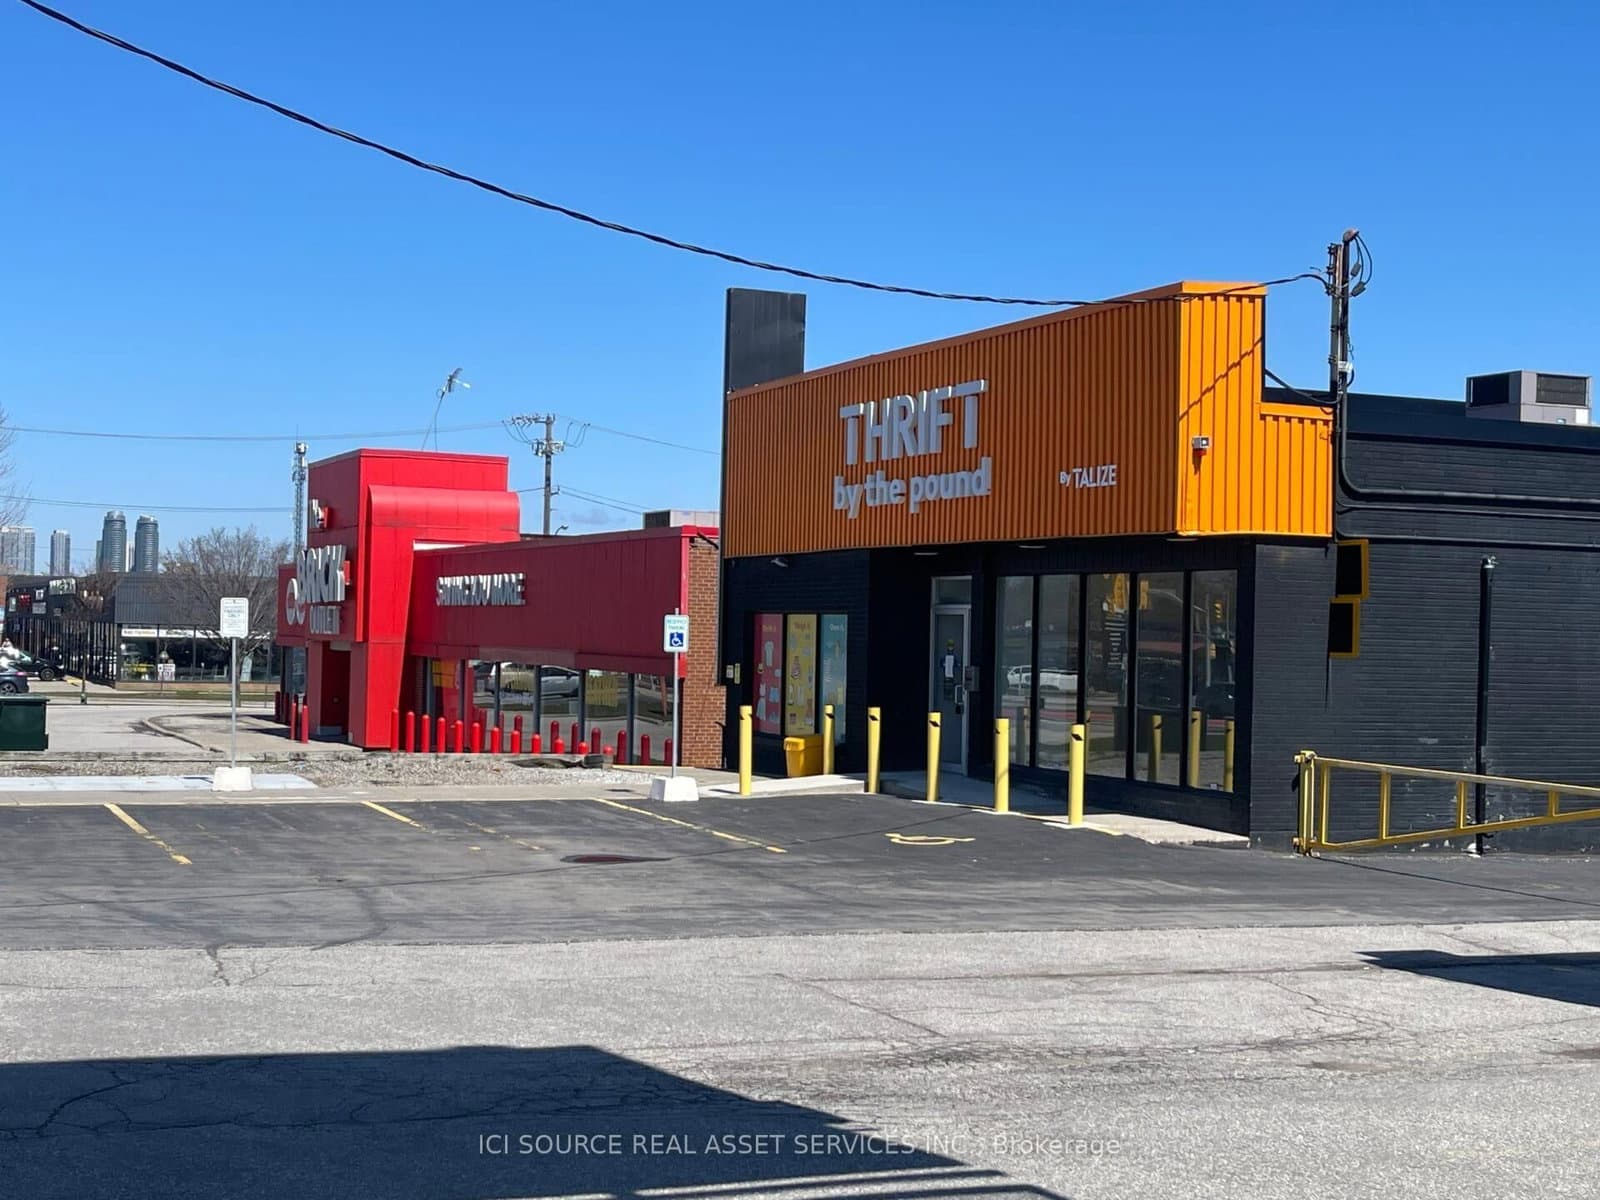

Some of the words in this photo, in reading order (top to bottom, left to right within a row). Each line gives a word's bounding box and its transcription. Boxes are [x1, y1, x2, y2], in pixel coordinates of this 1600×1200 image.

[840, 379, 989, 465] THRIFT
[834, 475, 861, 519] by
[864, 470, 905, 508] the
[909, 456, 993, 514] pound
[1072, 464, 1118, 489] TALIZE
[297, 544, 347, 604] BRICK
